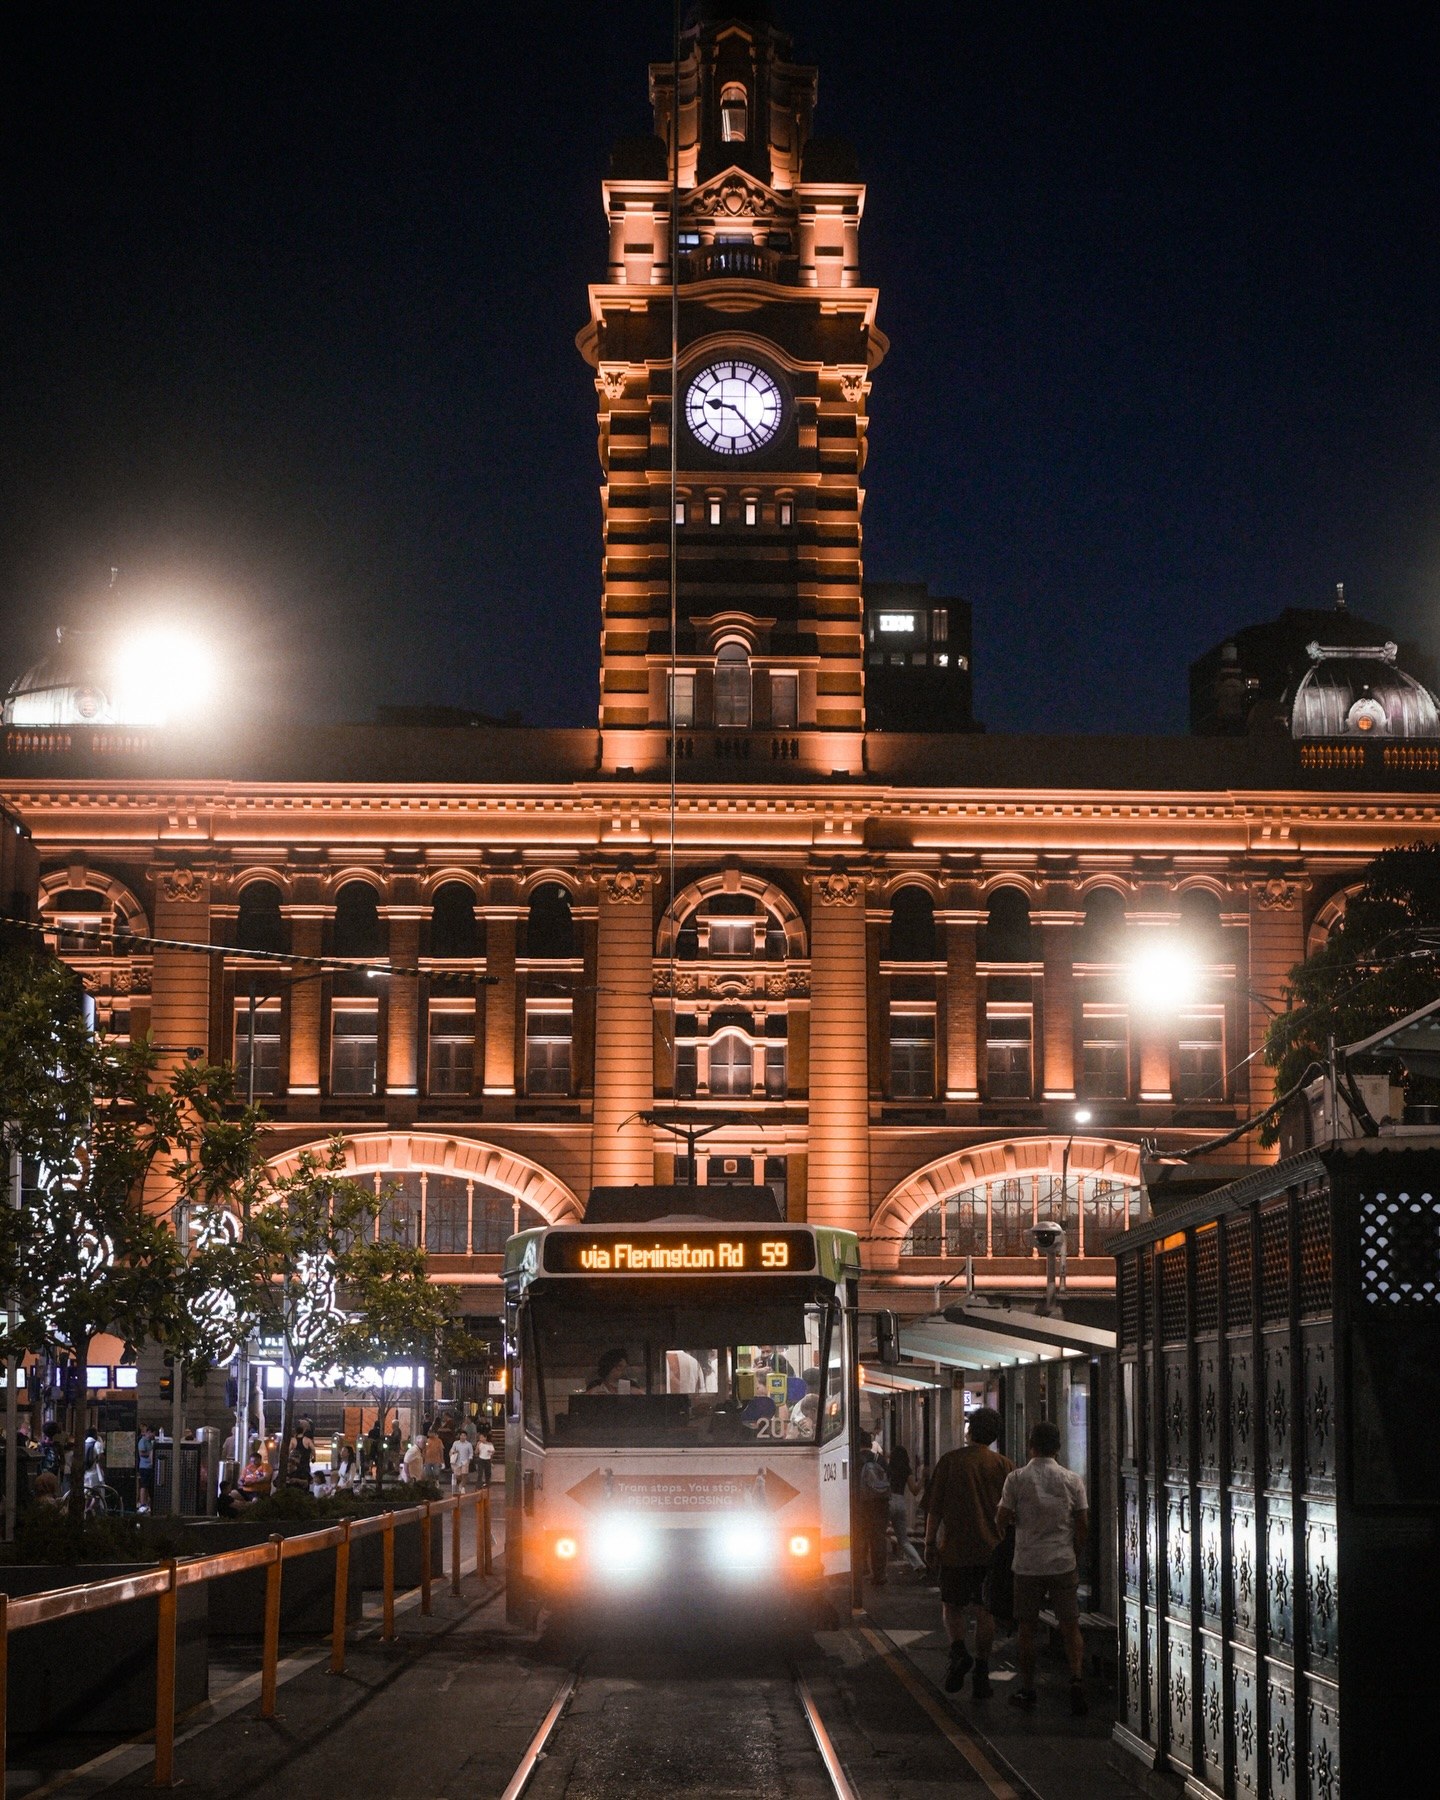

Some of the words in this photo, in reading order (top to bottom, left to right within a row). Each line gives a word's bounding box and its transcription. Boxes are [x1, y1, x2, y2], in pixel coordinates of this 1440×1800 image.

[581, 1244, 610, 1268] via
[614, 1243, 714, 1268] Flemington
[719, 1243, 743, 1267] Rd
[761, 1242, 788, 1267] 59
[823, 1462, 836, 1481] 2043
[650, 1483, 686, 1494] stops.
[688, 1483, 709, 1492] You
[628, 1495, 671, 1505] PEOPLE
[673, 1495, 731, 1505] CROSSING
